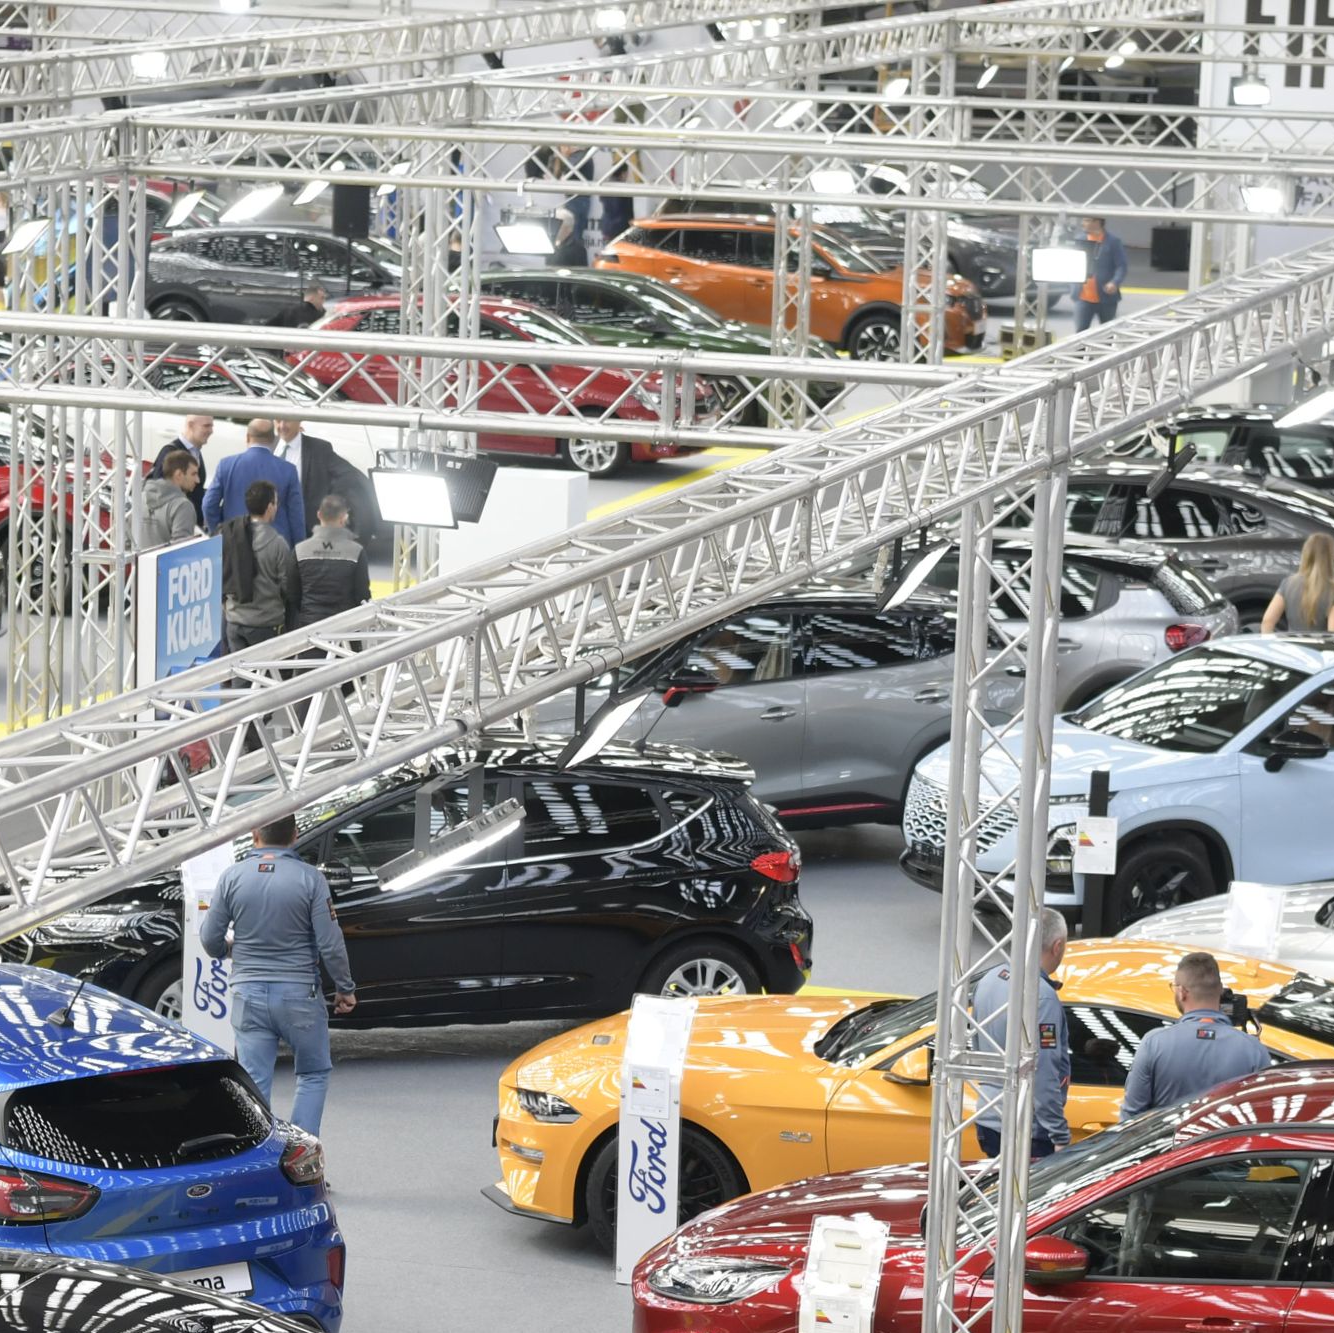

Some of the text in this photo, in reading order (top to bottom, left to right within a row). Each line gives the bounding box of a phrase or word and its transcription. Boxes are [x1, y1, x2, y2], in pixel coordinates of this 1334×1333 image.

[168, 558, 213, 610] FORD
[167, 604, 213, 656] KUGA
[628, 1117, 668, 1216] Ford
